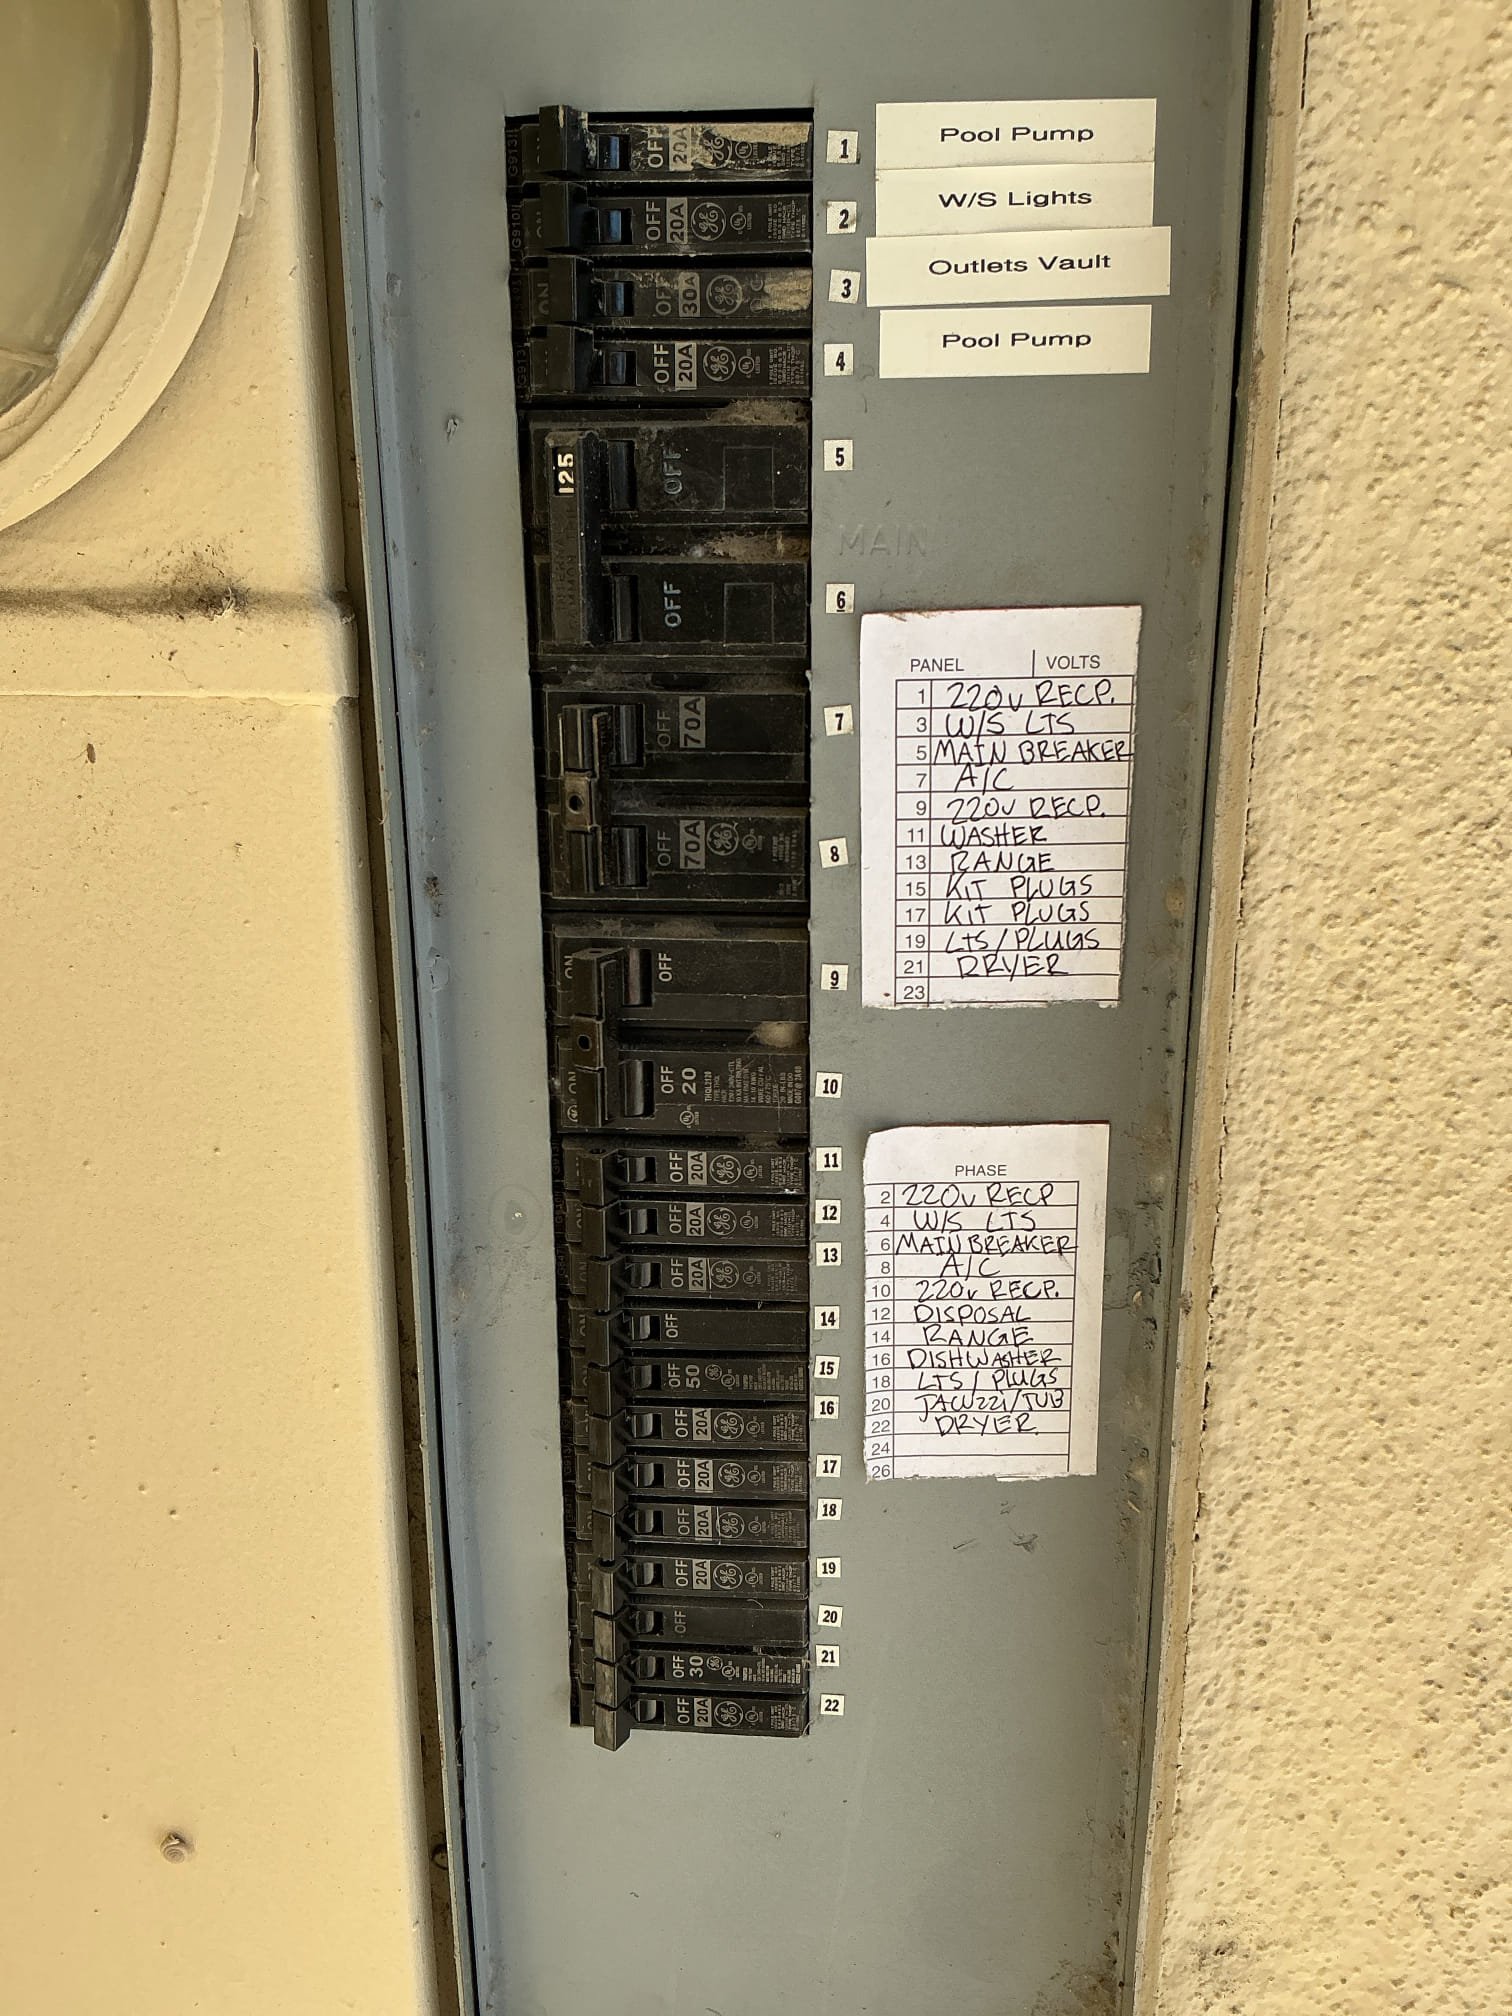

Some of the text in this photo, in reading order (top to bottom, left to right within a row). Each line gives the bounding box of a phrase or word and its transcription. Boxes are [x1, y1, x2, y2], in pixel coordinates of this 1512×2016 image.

[939, 126, 1094, 143] Pool Pump
[673, 126, 688, 165] 20A
[840, 139, 849, 159] 1
[938, 191, 1092, 208] W/S Lights
[646, 201, 661, 241] OFF
[670, 203, 685, 243] 20A
[838, 209, 849, 229] 2
[928, 254, 1111, 276] Outlets Vault
[682, 275, 698, 315] 30A
[841, 278, 852, 299] 3
[942, 332, 1092, 349] Pool Pump
[654, 343, 693, 384] OFF 20A
[835, 351, 846, 372] 4
[835, 447, 845, 466] 5
[557, 452, 575, 495] 125
[662, 450, 682, 495] OFF
[839, 523, 928, 557] MAIN
[663, 581, 682, 628] OFF
[836, 591, 846, 612] 6
[910, 655, 1101, 672] PANEL VOLTS
[918, 688, 925, 704] 1
[657, 696, 701, 747] OFF 70A
[834, 713, 844, 731] 7
[916, 717, 927, 732] 3
[1026, 710, 1075, 735] LTS
[916, 745, 927, 760] 5
[934, 739, 1134, 767] MAIN BREAKER
[916, 773, 927, 788] 7
[954, 763, 1014, 795] A/C
[916, 801, 927, 815] 9
[657, 821, 701, 868] OFF 70A
[907, 828, 925, 843] 11
[941, 823, 1047, 850] WASHER
[830, 846, 839, 863] 8
[906, 855, 927, 870] 13
[951, 850, 1055, 873] RANGE
[906, 882, 926, 896] 15
[1010, 874, 1093, 901] PLUGS
[906, 908, 926, 923] 17
[1011, 901, 1090, 925] PLUGS
[906, 934, 926, 948] 19
[658, 953, 673, 982] OFF
[904, 960, 924, 974] 21
[957, 952, 1069, 981] DRYER
[830, 970, 839, 989] 9
[904, 986, 925, 1000] 23
[660, 1066, 675, 1094] OFF
[682, 1066, 697, 1095] 20
[822, 1078, 838, 1095] 10
[669, 1152, 704, 1183] OFF 20A
[823, 1152, 839, 1168] 11
[955, 1164, 1008, 1177] PHASE
[880, 1191, 891, 1204] 2
[987, 1182, 1054, 1206] RECP
[669, 1203, 702, 1235] OFF 20A
[822, 1205, 838, 1221] 12
[880, 1214, 891, 1227] 4
[986, 1209, 1036, 1232] LTS
[880, 1238, 891, 1251] 6
[896, 1232, 1079, 1257] MAIN BREAKER
[823, 1248, 838, 1263] 13
[671, 1257, 704, 1288] OFF 20A
[880, 1261, 891, 1274] 8
[939, 1253, 1000, 1281] A/C
[872, 1285, 891, 1297] 10
[820, 1311, 836, 1327] 14
[872, 1308, 891, 1321] 12
[914, 1304, 1031, 1324] DISPOSAL
[665, 1313, 679, 1338] OFF
[923, 1323, 1034, 1346] RANGE
[872, 1330, 891, 1343] 14
[819, 1361, 835, 1375] 15
[872, 1353, 891, 1366] 16
[907, 1348, 1062, 1369] DISHWASHER
[668, 1362, 701, 1389] OFF 50
[872, 1376, 891, 1388] 18
[819, 1400, 835, 1415] 16
[872, 1398, 891, 1411] 20
[675, 1408, 708, 1438] OFF 20A
[872, 1420, 891, 1433] 22
[872, 1443, 891, 1456] 24
[677, 1459, 710, 1488] OFF 20A
[822, 1460, 838, 1474] 17
[872, 1465, 891, 1478] 26
[822, 1503, 837, 1516] 18
[678, 1507, 710, 1536] OFF 20A
[676, 1559, 708, 1587] OFF 20A
[822, 1562, 836, 1575] 19
[674, 1609, 687, 1634] OFF
[823, 1610, 838, 1623] 20
[821, 1650, 836, 1663] 21
[672, 1654, 704, 1679] OFF 30
[677, 1697, 709, 1724] OFF 20A
[824, 1699, 839, 1712] 22
